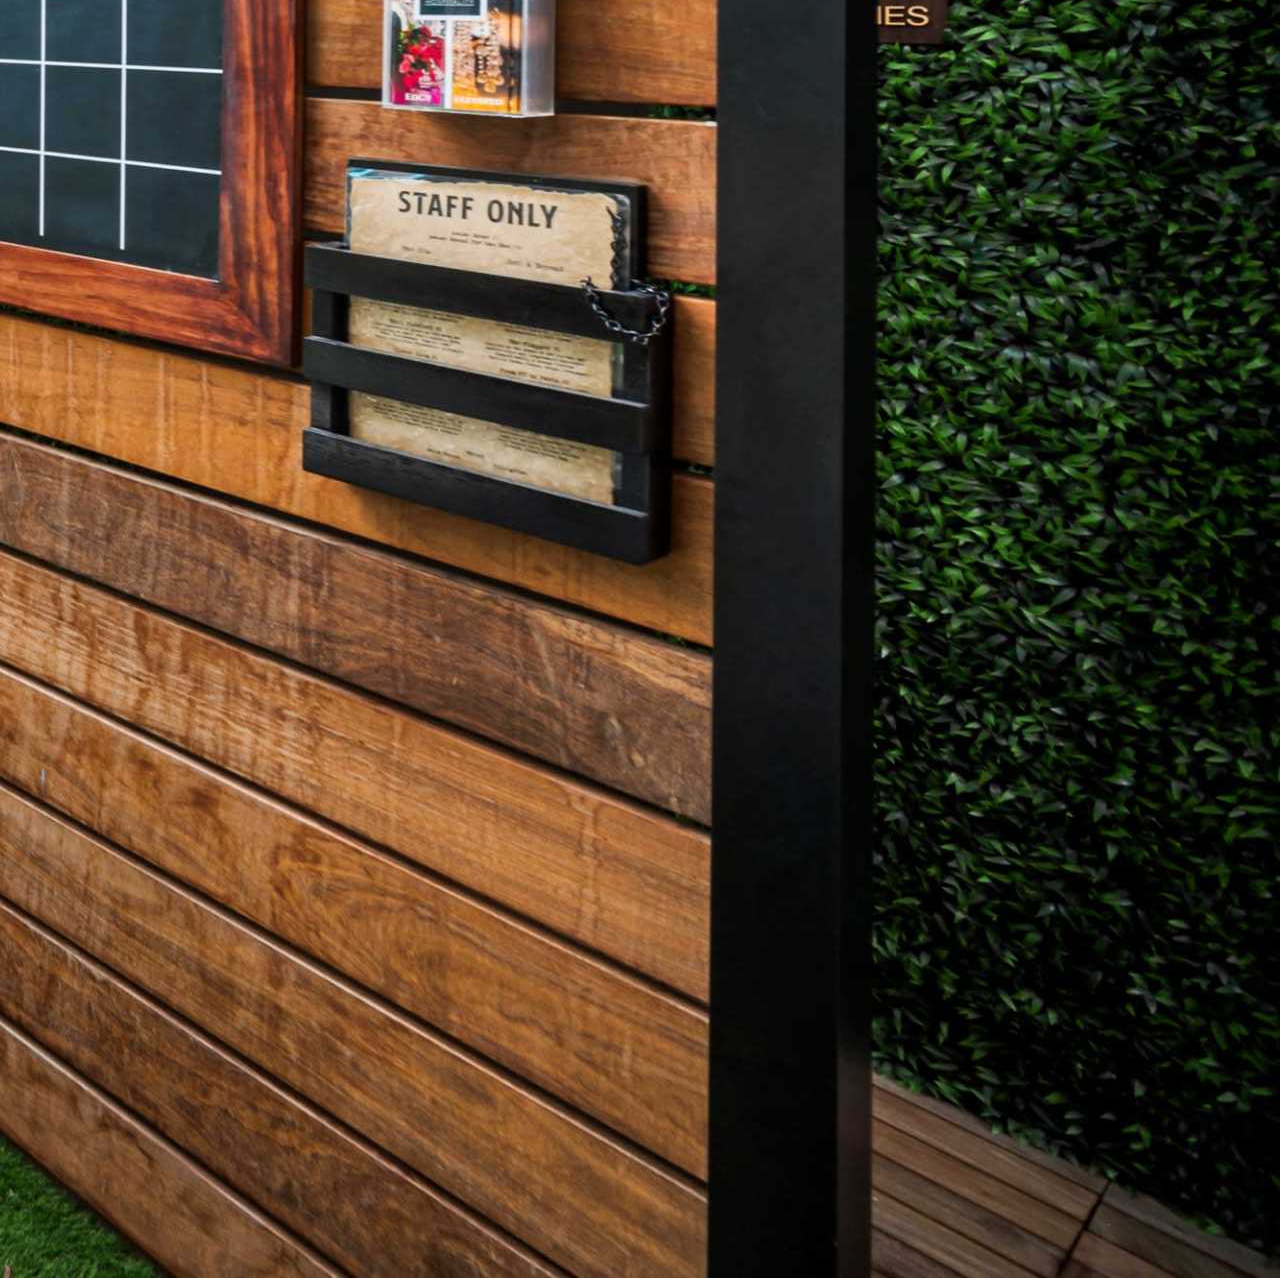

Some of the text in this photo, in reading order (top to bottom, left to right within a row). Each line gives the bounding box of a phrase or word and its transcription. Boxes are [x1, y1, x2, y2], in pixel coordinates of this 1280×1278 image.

[877, 5, 930, 27] IES
[397, 190, 559, 230] STAFF ONLY
